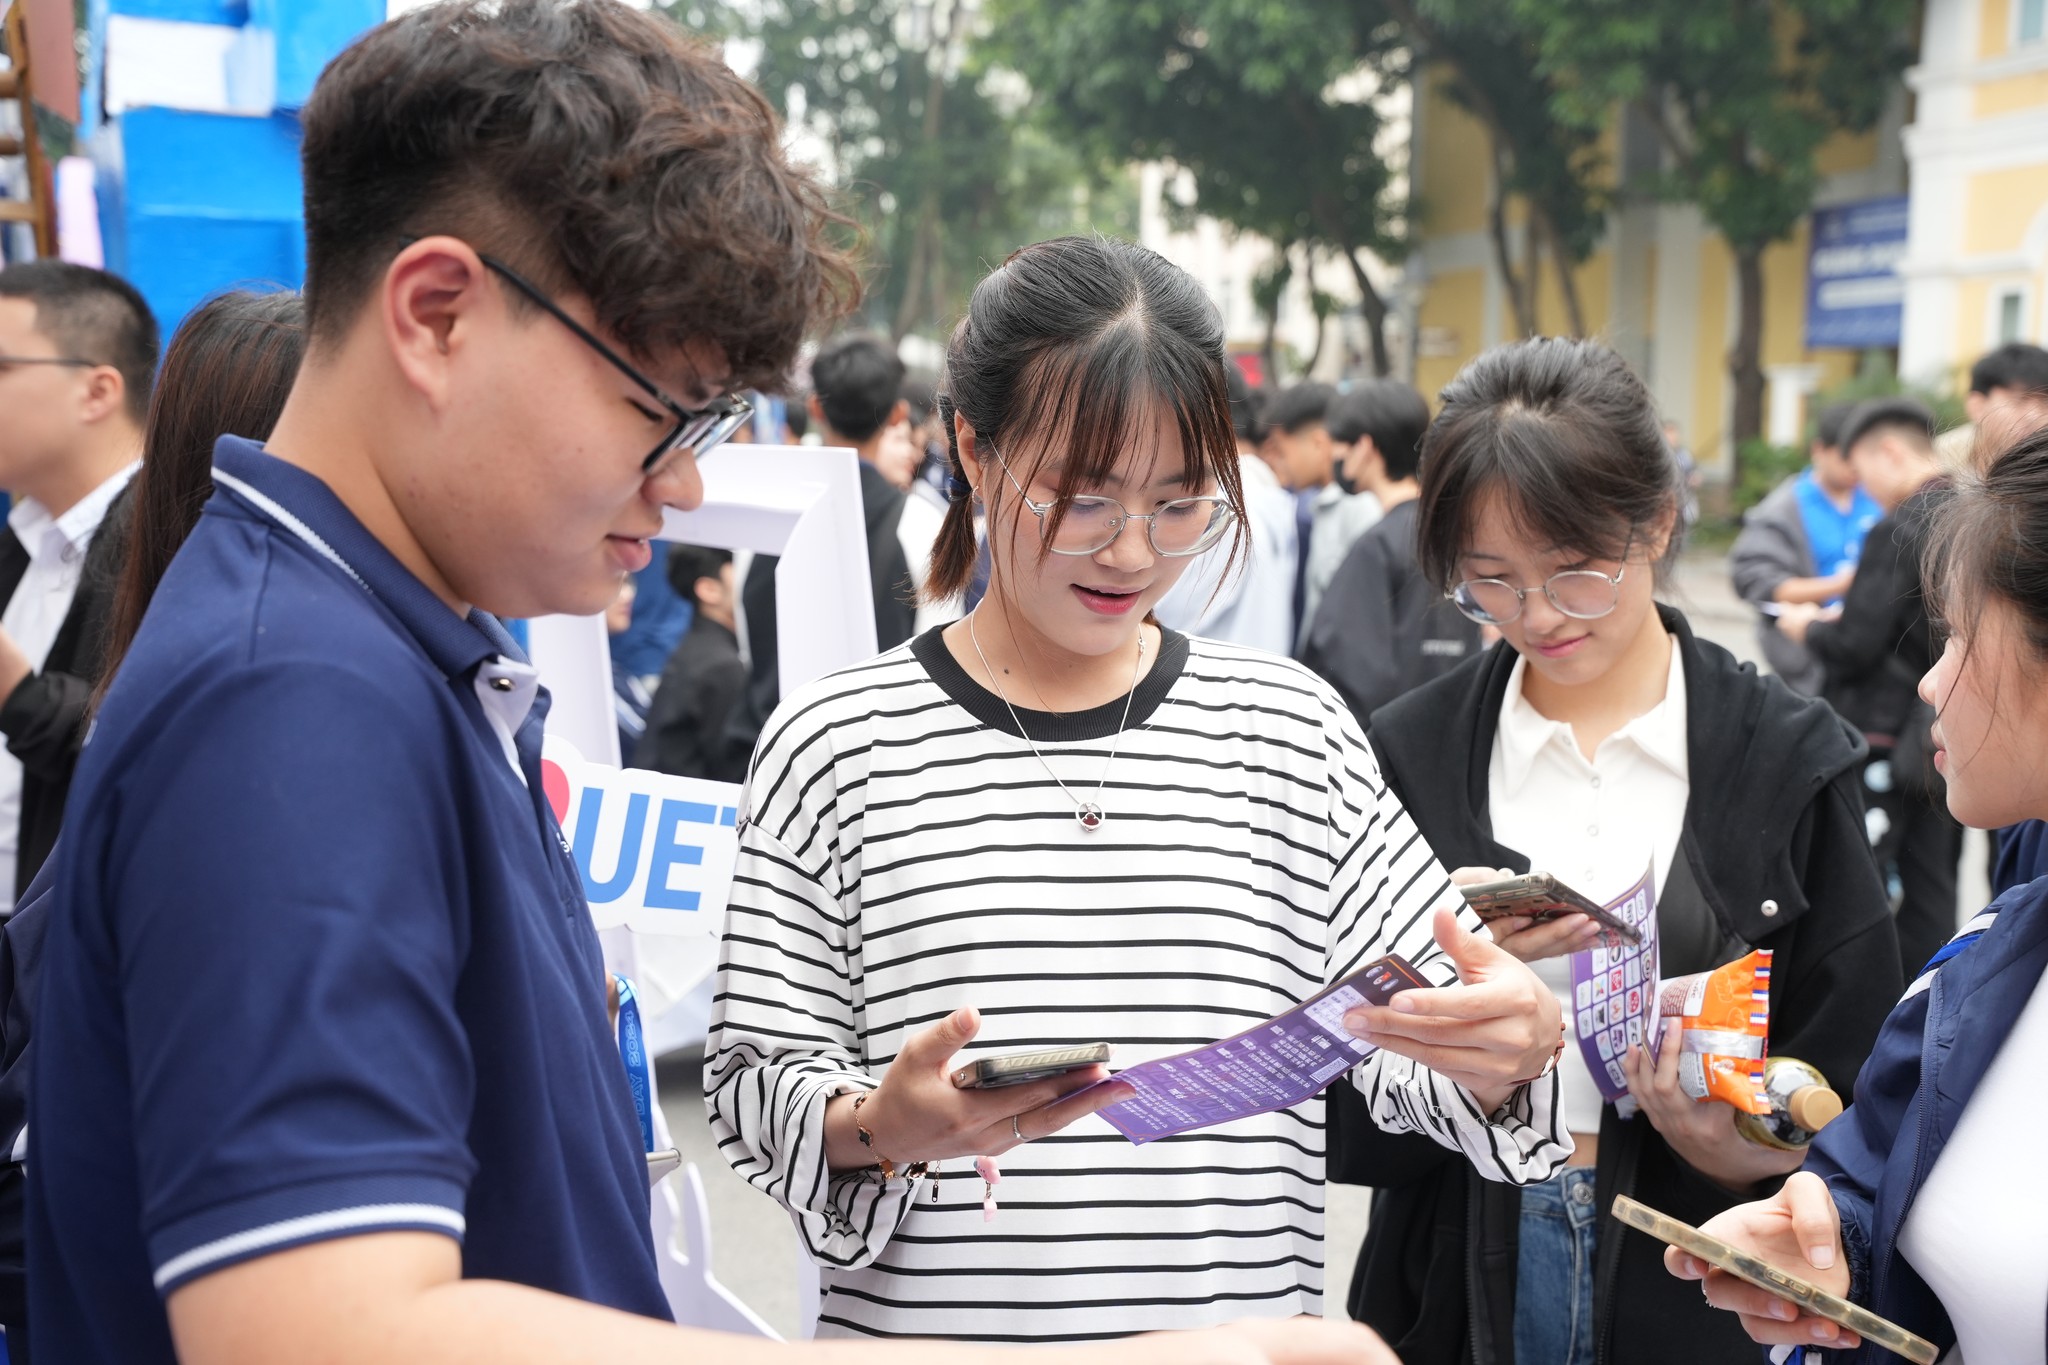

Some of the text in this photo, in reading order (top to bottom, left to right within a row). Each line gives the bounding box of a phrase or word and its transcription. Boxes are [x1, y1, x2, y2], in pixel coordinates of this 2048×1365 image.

[571, 787, 738, 911] UE
[625, 1010, 641, 1067] 2024
[630, 1073, 646, 1115] DAY
